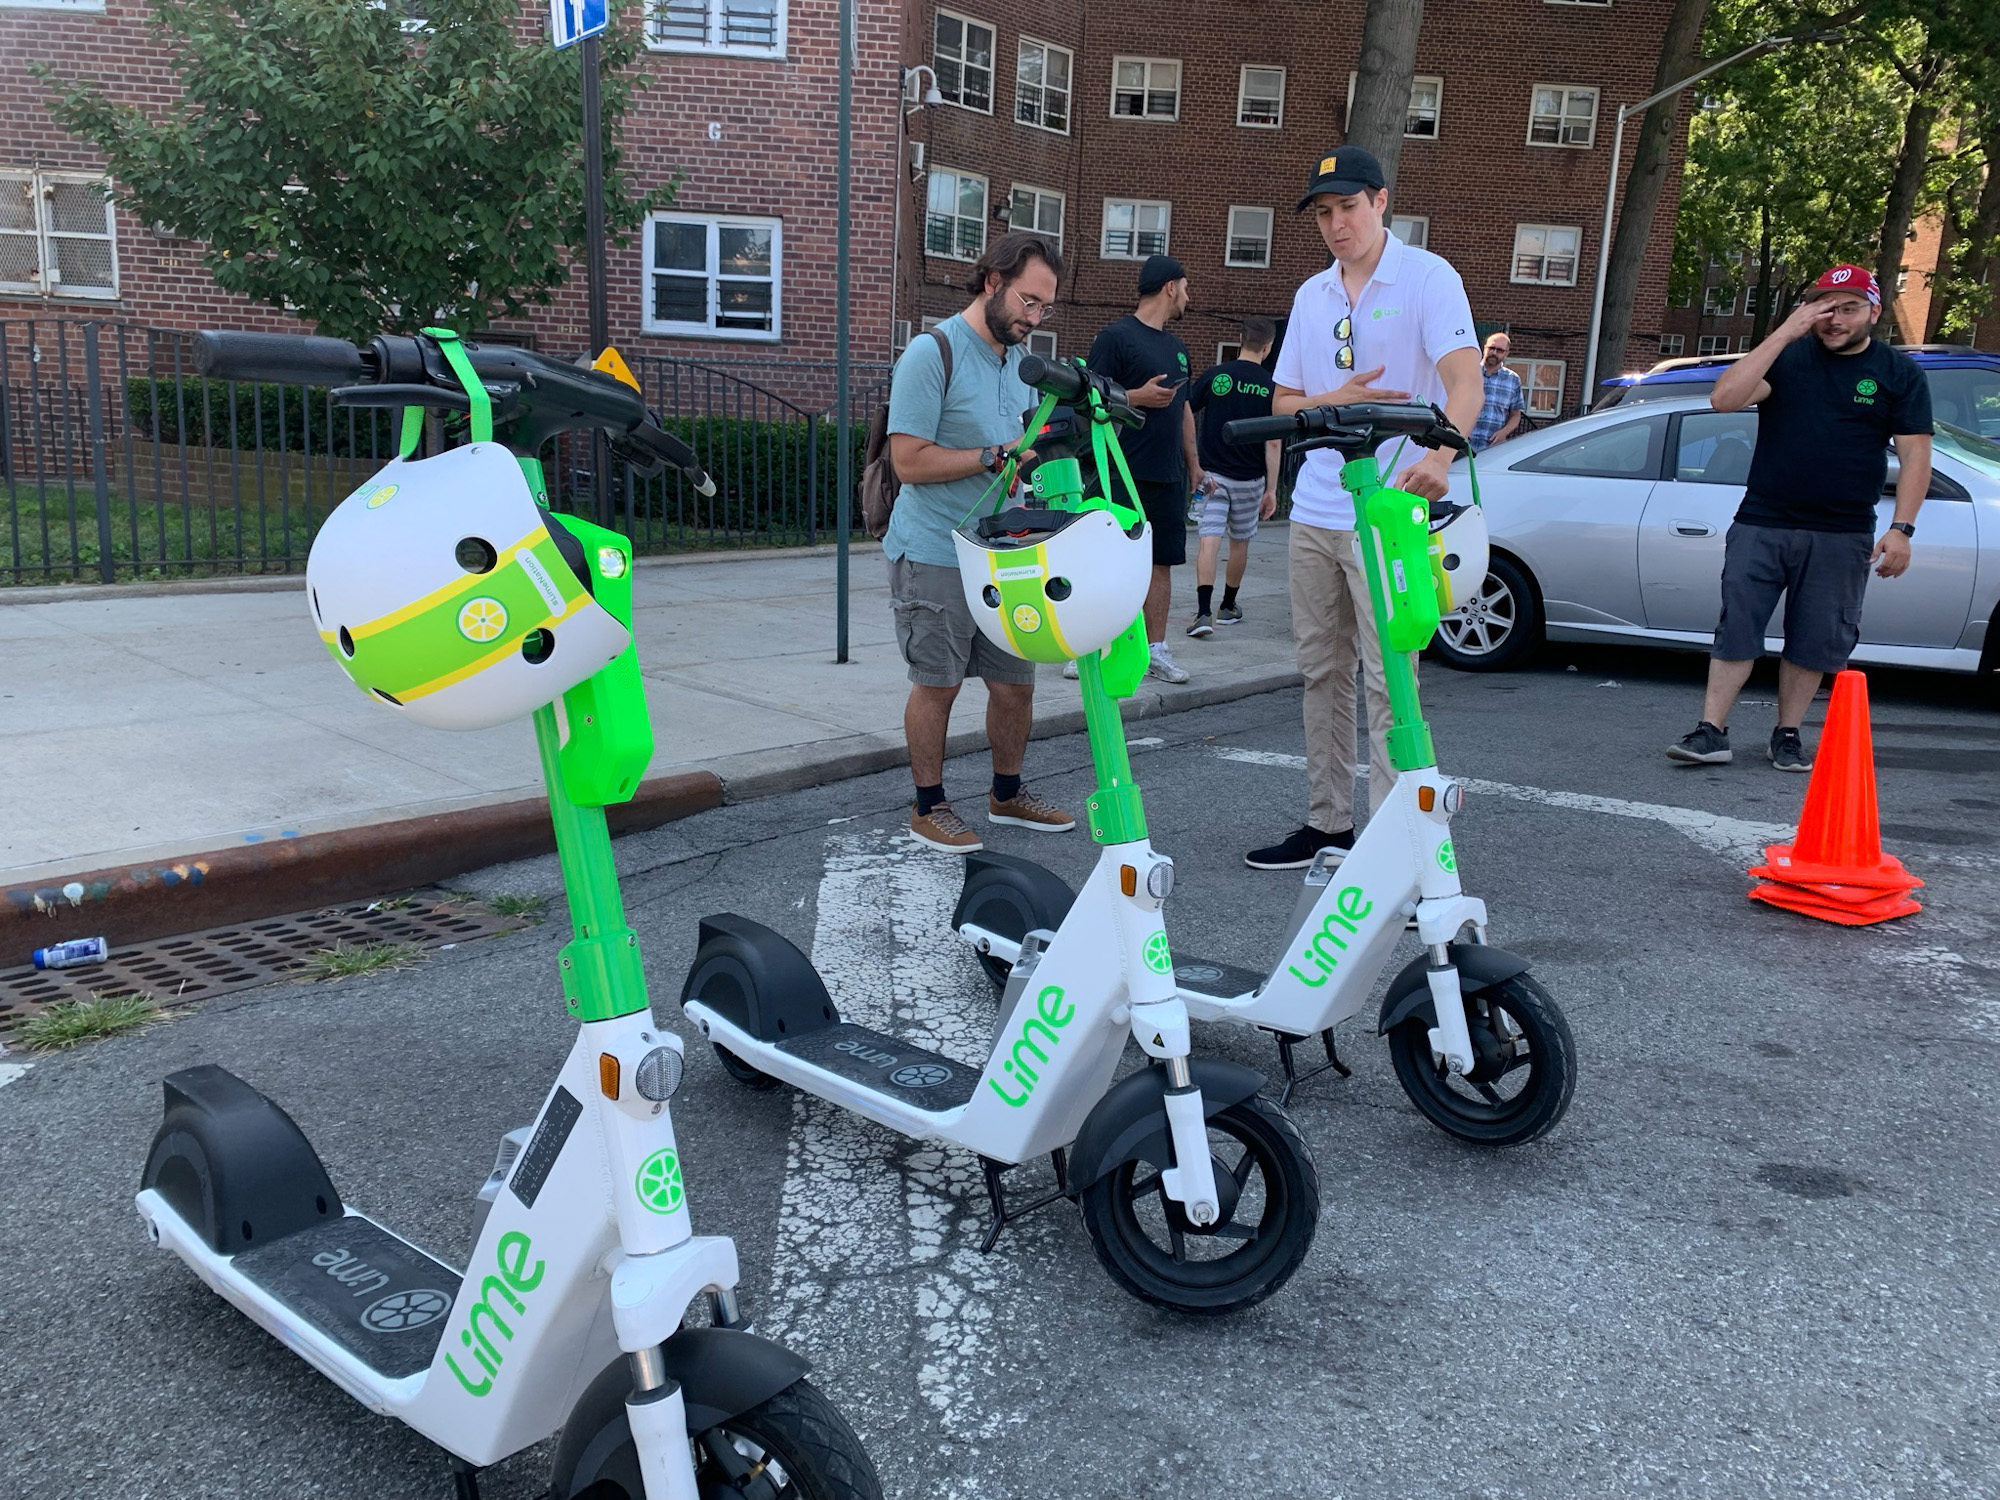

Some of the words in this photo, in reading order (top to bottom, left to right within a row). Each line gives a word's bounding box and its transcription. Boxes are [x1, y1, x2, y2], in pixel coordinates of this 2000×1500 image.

[708, 121, 722, 140] G
[1832, 268, 1852, 284] W
[1237, 380, 1270, 398] Lime
[524, 556, 559, 607] #LimeNation
[1288, 886, 1373, 988] Lime
[834, 1040, 898, 1069] Lime
[988, 985, 1075, 1108] Lime
[311, 1248, 390, 1297] Lime
[444, 1230, 546, 1398] Lime
